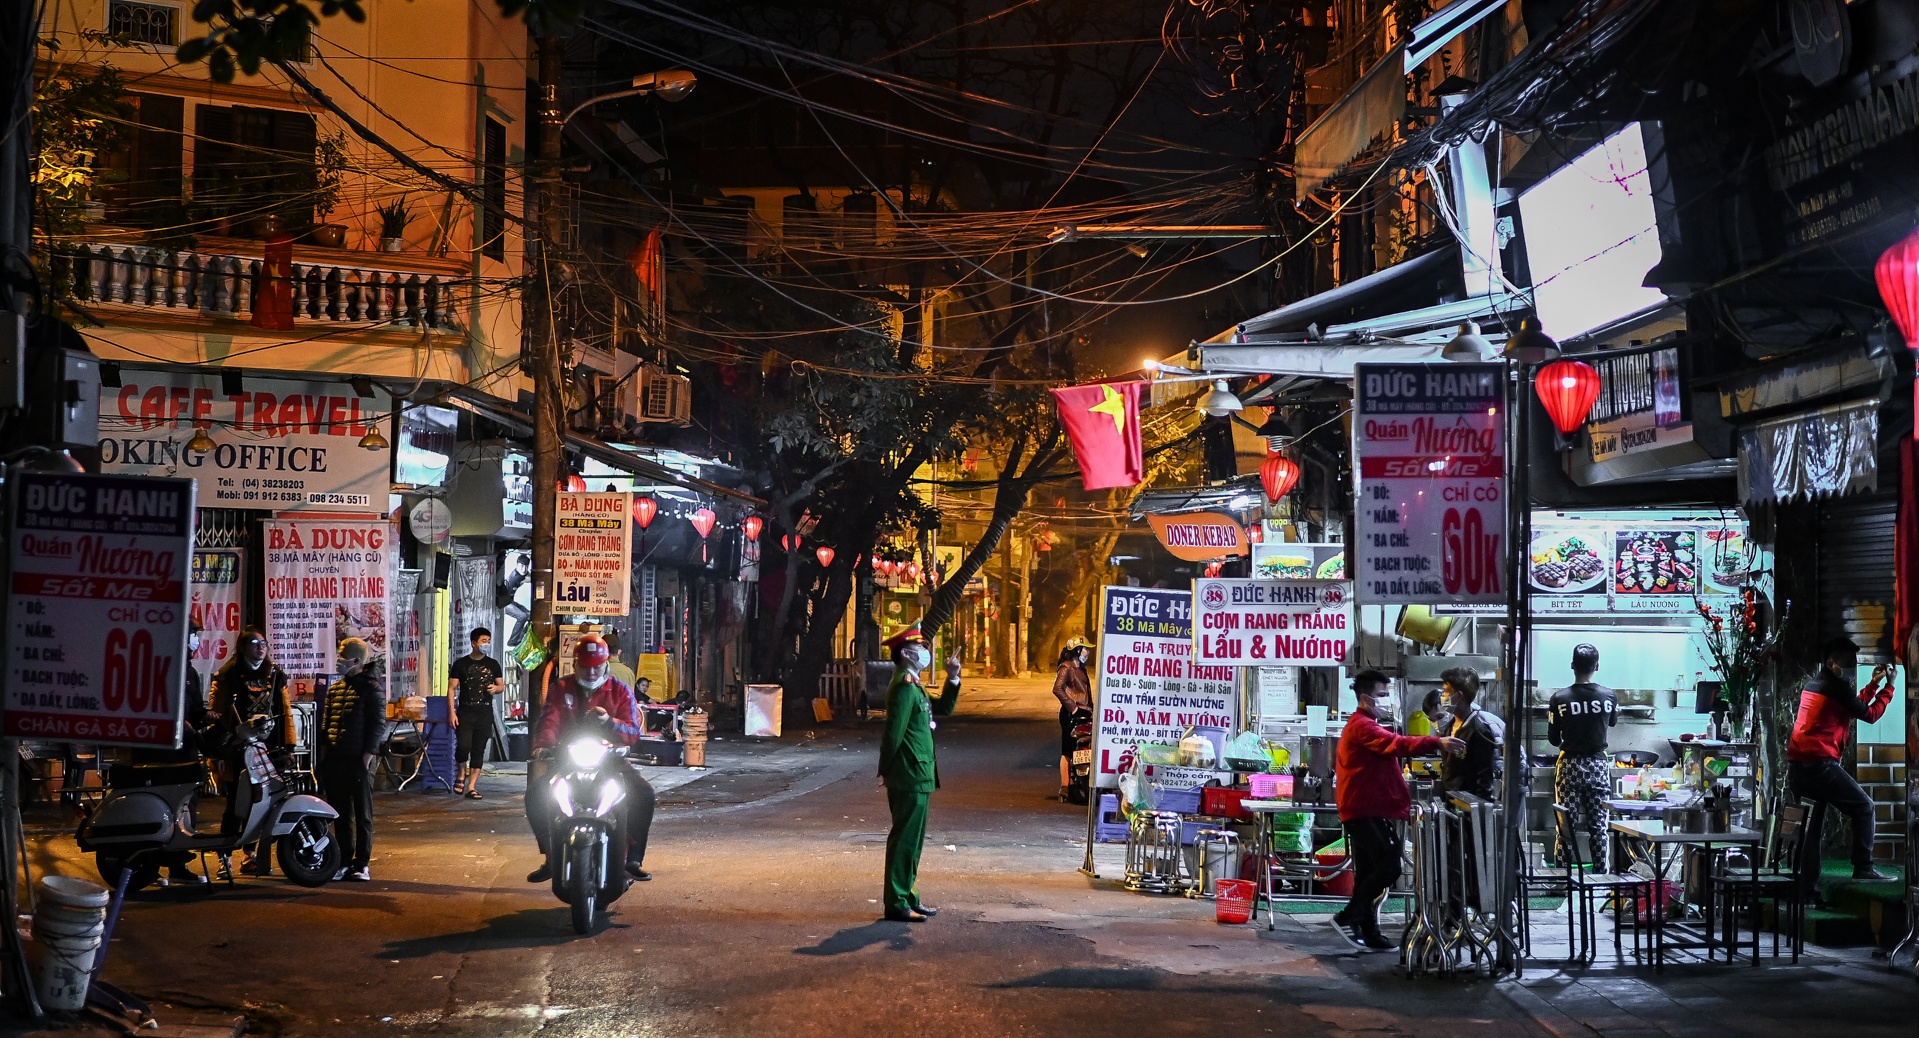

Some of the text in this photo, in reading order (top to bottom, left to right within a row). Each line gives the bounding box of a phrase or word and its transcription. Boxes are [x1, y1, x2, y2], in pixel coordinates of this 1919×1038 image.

[1366, 370, 1494, 401] ĐỨC HẠNH
[118, 384, 369, 438] CAFE TRAVEL
[1366, 400, 1376, 412] 38
[1366, 417, 1496, 465] Quán Nướng
[214, 443, 328, 473] OFFICE
[1443, 462, 1478, 476] Me
[218, 478, 304, 489] Tel: (04) 38238203
[1443, 482, 1468, 501] CHỈ
[1474, 482, 1498, 501] CÓ
[26, 482, 178, 521] ĐỨC HẠNH
[244, 490, 258, 500] 091
[262, 491, 278, 501] 912
[280, 492, 302, 502] 6383
[310, 494, 326, 504] 098
[328, 494, 344, 504] 234
[347, 494, 368, 505] 5511
[560, 495, 622, 512] BÀ DUNG
[562, 519, 620, 528] 38 Mã Mây
[268, 523, 384, 550] BÀ DUNG
[559, 530, 621, 551] CƠM RANG TRẮNG
[1166, 524, 1238, 547] DONER KEBAB
[1374, 529, 1410, 547] BA CHỈ:
[268, 551, 382, 564] 38 MÃ MÂY (HÀNG CŨ)
[1442, 507, 1500, 594] 60K
[22, 534, 176, 590] Quán Nướng
[309, 566, 340, 574] CHUYÊN
[558, 557, 567, 569] BÒ
[1374, 555, 1430, 574] BẠCH TUỘC:
[589, 570, 601, 578] SỐT
[41, 577, 152, 599] Sốt Me
[268, 570, 385, 600] CƠM RANG TRẮNG
[557, 578, 590, 602] Lẩu
[1206, 590, 1223, 602] 38
[1232, 583, 1264, 602] ĐỨC
[1270, 586, 1316, 606] HẠNH
[1325, 590, 1342, 602] 38
[1374, 580, 1388, 597] DẠ
[1111, 594, 1159, 618] ĐỨC
[1551, 599, 1583, 608] BÍT TẾT
[108, 603, 140, 623] CHỈ
[145, 606, 174, 624] CÓ
[1203, 608, 1346, 629] CƠM RANG TRẮNG
[1116, 617, 1182, 637] 38 Mã Mây
[24, 646, 39, 660] BA
[1133, 642, 1154, 654] GIA
[1203, 629, 1346, 662] Lẩu & Nướng
[104, 627, 172, 714] 60K
[1107, 654, 1182, 678] CƠM RANG
[22, 670, 53, 686] BẠCH
[1106, 677, 1231, 695] Dưa Bò Sườn Lòng Gà Hải Sản
[20, 692, 37, 709] DẠ
[1111, 691, 1224, 709] CƠM TẤM SƯỜN NƯỚNG
[1103, 706, 1230, 728] BÒ, NẦM NƯỚNG
[18, 716, 158, 739] CHÂN GÀ SẢ ỚT
[1102, 726, 1182, 738] PHỞ, MỲ XÀO BÍT TẾT
[1111, 736, 1146, 745] CHÁO
[1166, 772, 1189, 780] Thập
